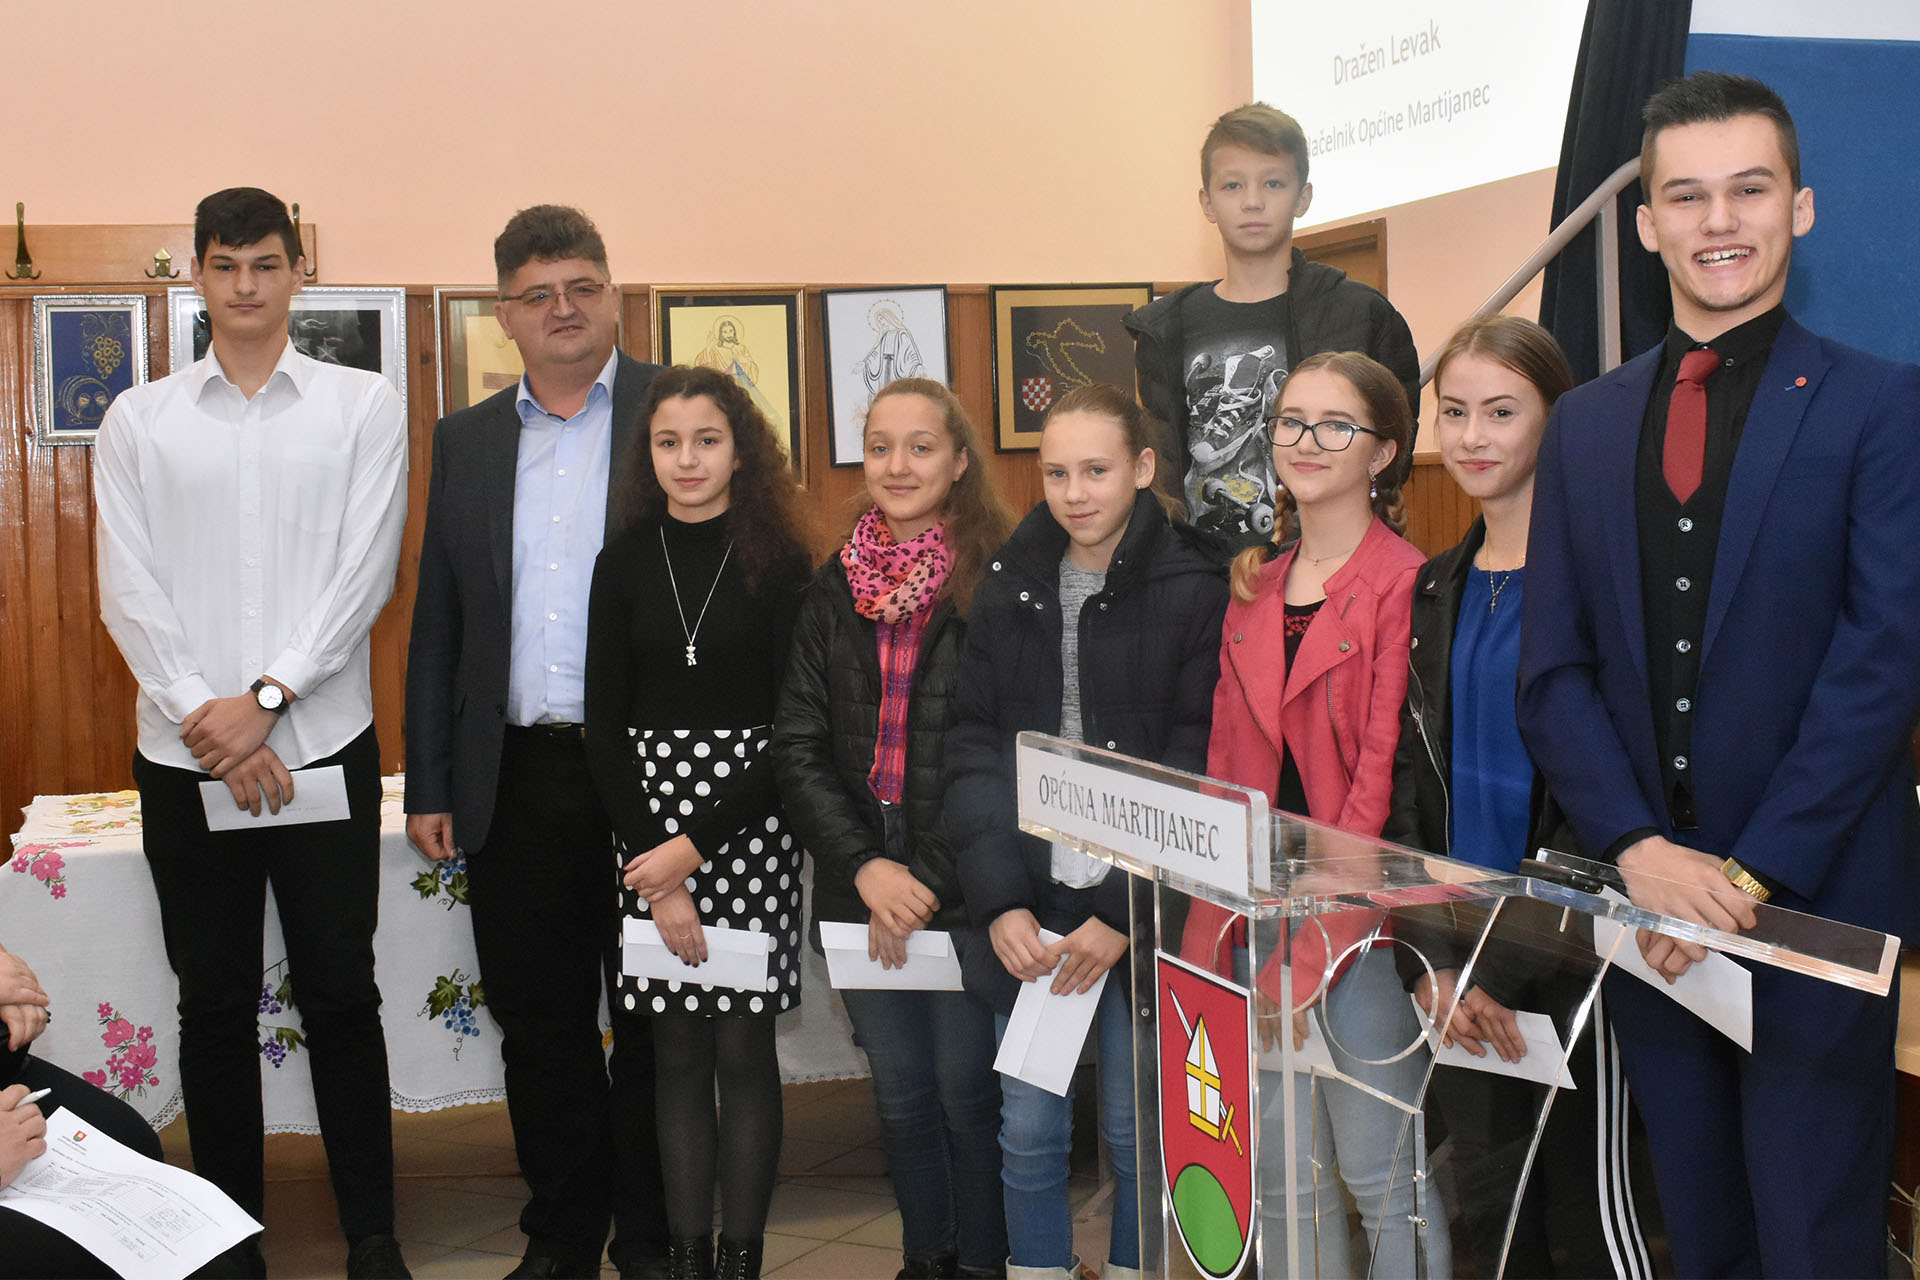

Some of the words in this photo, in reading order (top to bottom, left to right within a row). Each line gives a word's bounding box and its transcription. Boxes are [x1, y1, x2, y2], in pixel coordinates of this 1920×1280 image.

[1333, 44, 1386, 86] Dražen
[1391, 19, 1441, 65] Levak
[1358, 110, 1404, 147] Općine
[1408, 83, 1491, 130] Martijanec
[1038, 769, 1097, 822] OPĆINA
[1102, 792, 1221, 862] MARTIJANEC
